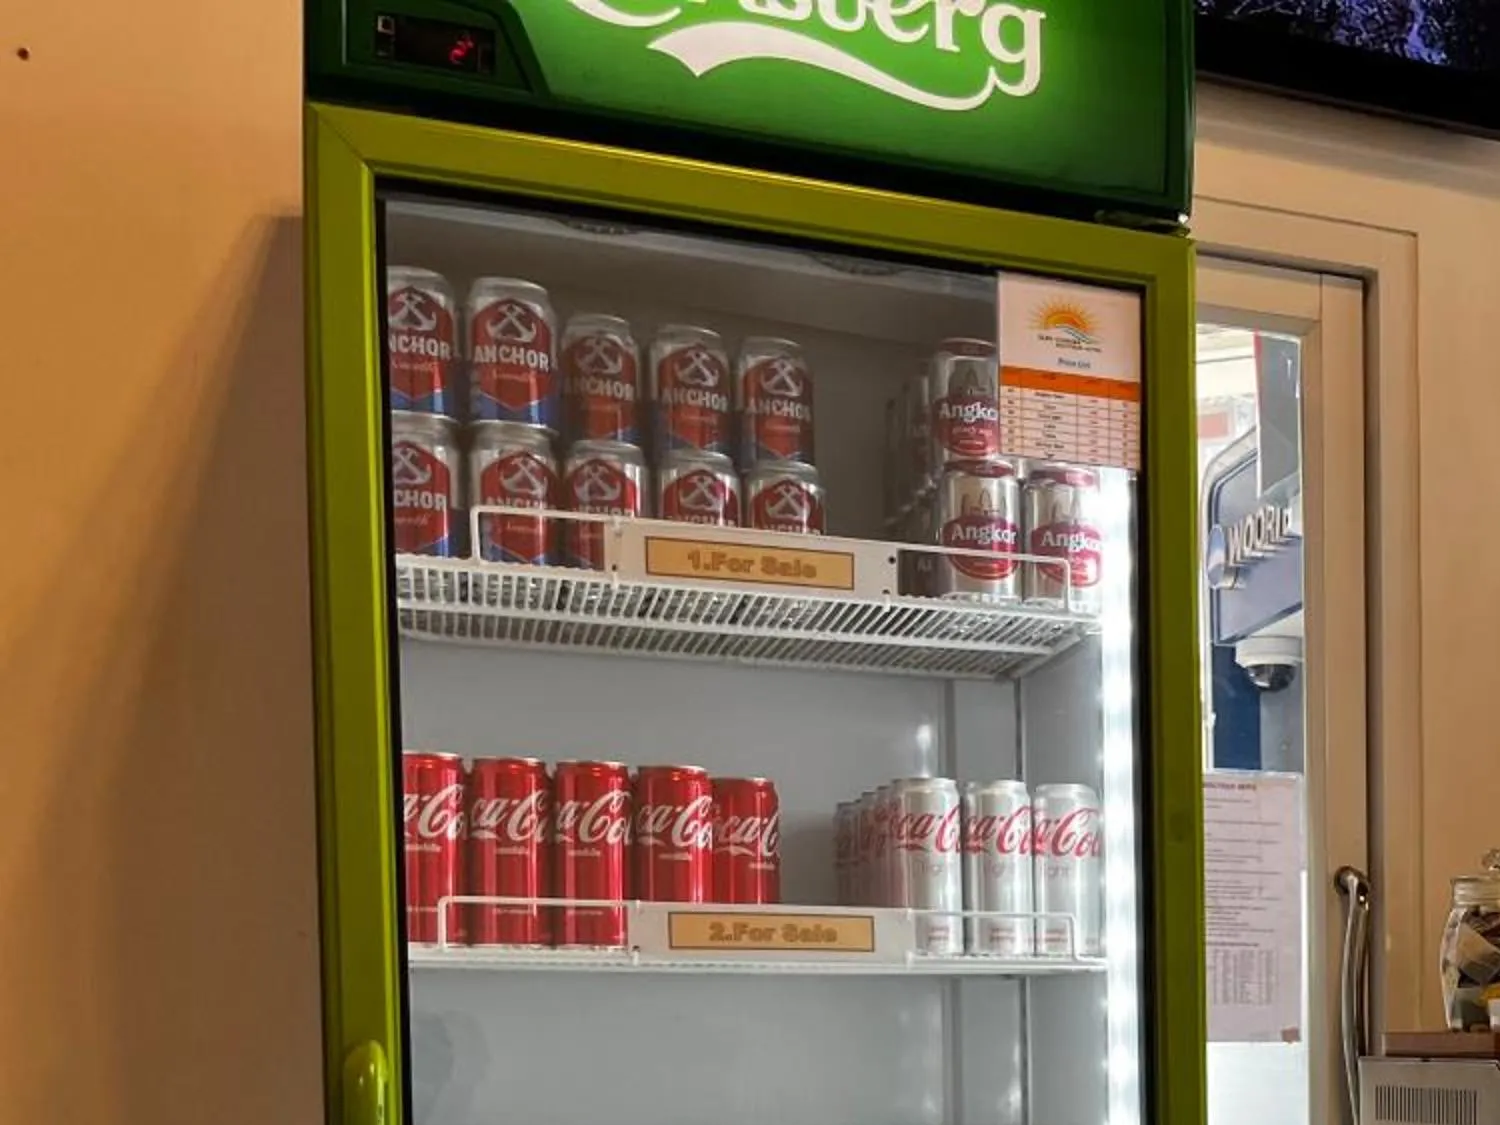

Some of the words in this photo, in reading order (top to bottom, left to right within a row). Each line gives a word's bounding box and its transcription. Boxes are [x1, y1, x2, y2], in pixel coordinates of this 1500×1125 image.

[474, 344, 549, 372] ANCHOR
[939, 401, 998, 423] Angko
[394, 489, 447, 512] CHOR
[950, 523, 1017, 546] Angkor
